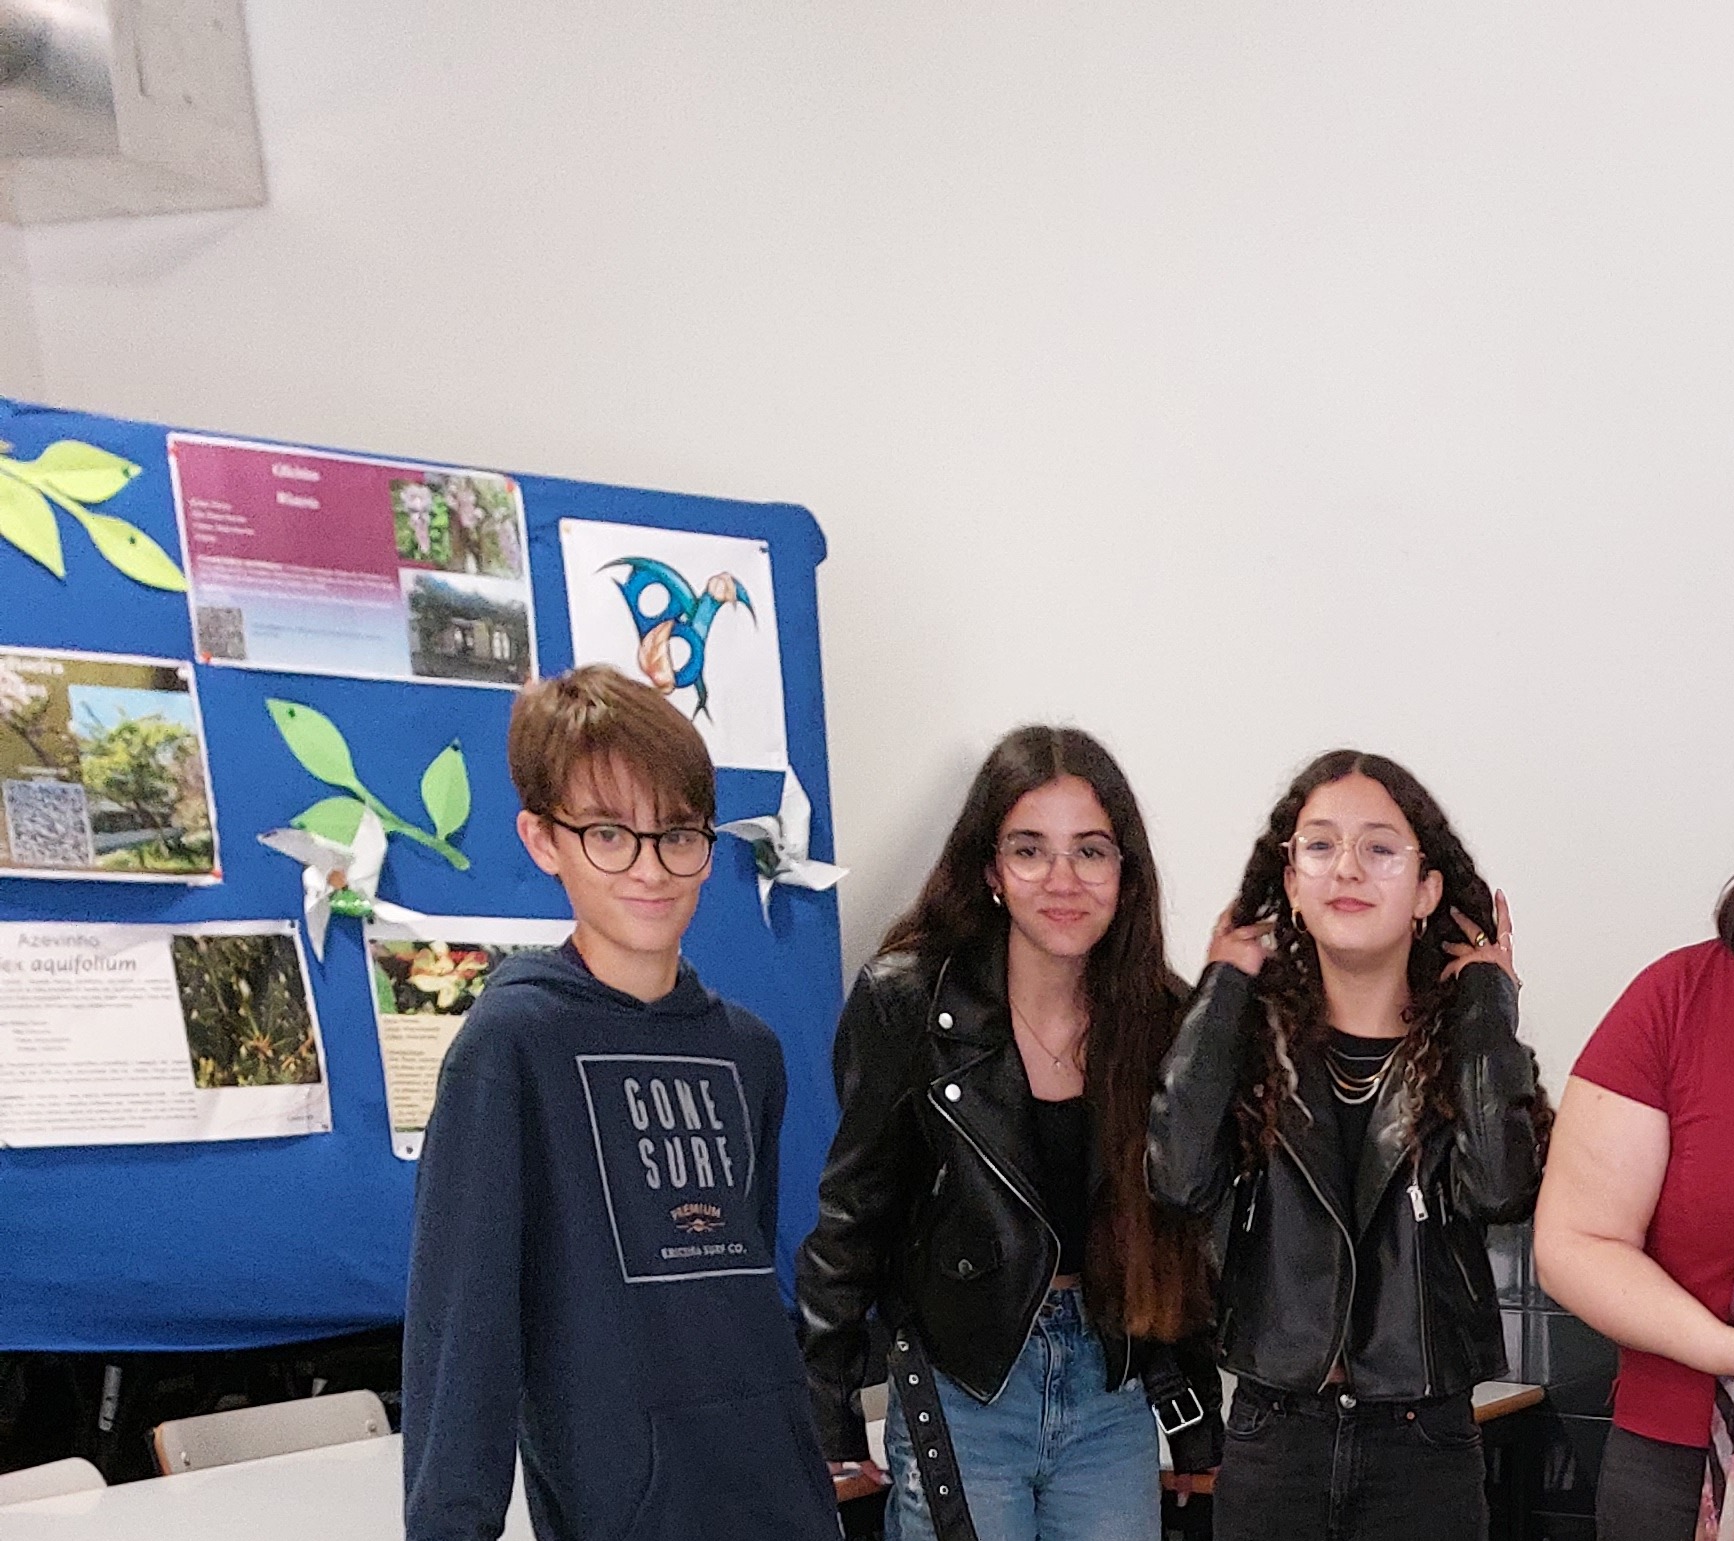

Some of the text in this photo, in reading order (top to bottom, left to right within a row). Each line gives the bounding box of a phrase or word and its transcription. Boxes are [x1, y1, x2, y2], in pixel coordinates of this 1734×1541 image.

[31, 954, 137, 976] aquifolium
[623, 1077, 724, 1131] GONE
[637, 1136, 735, 1190] SURF
